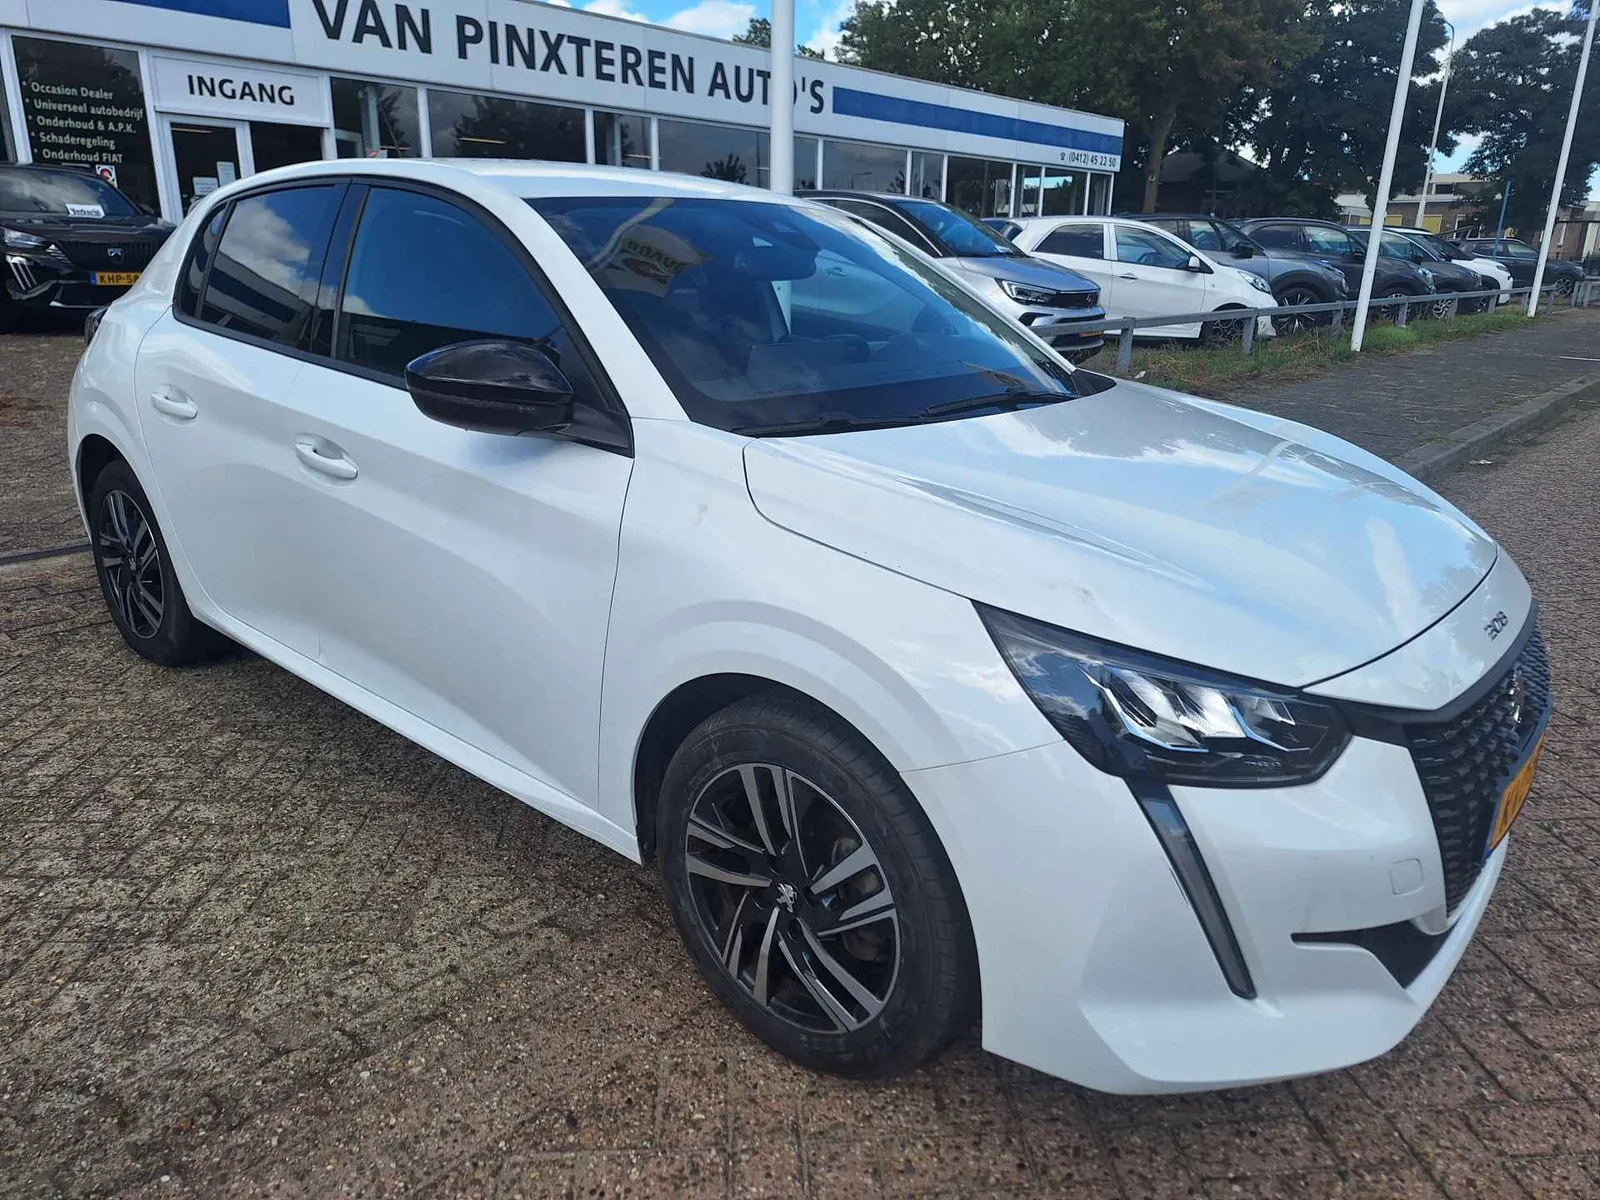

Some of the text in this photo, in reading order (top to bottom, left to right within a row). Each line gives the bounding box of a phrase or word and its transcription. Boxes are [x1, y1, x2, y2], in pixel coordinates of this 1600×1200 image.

[313, 0, 824, 114] VAN PINXTEREN AUT'S
[31, 82, 113, 100] Occasion Dealer
[187, 74, 295, 106] INGANG
[33, 99, 144, 121] Universeel autobedrijf
[36, 115, 137, 134] Onderhoud & A.P.K.
[39, 132, 116, 150] Schaderegeling
[42, 148, 123, 164] Onderhoud FIAT
[1068, 151, 1089, 165] (0412)
